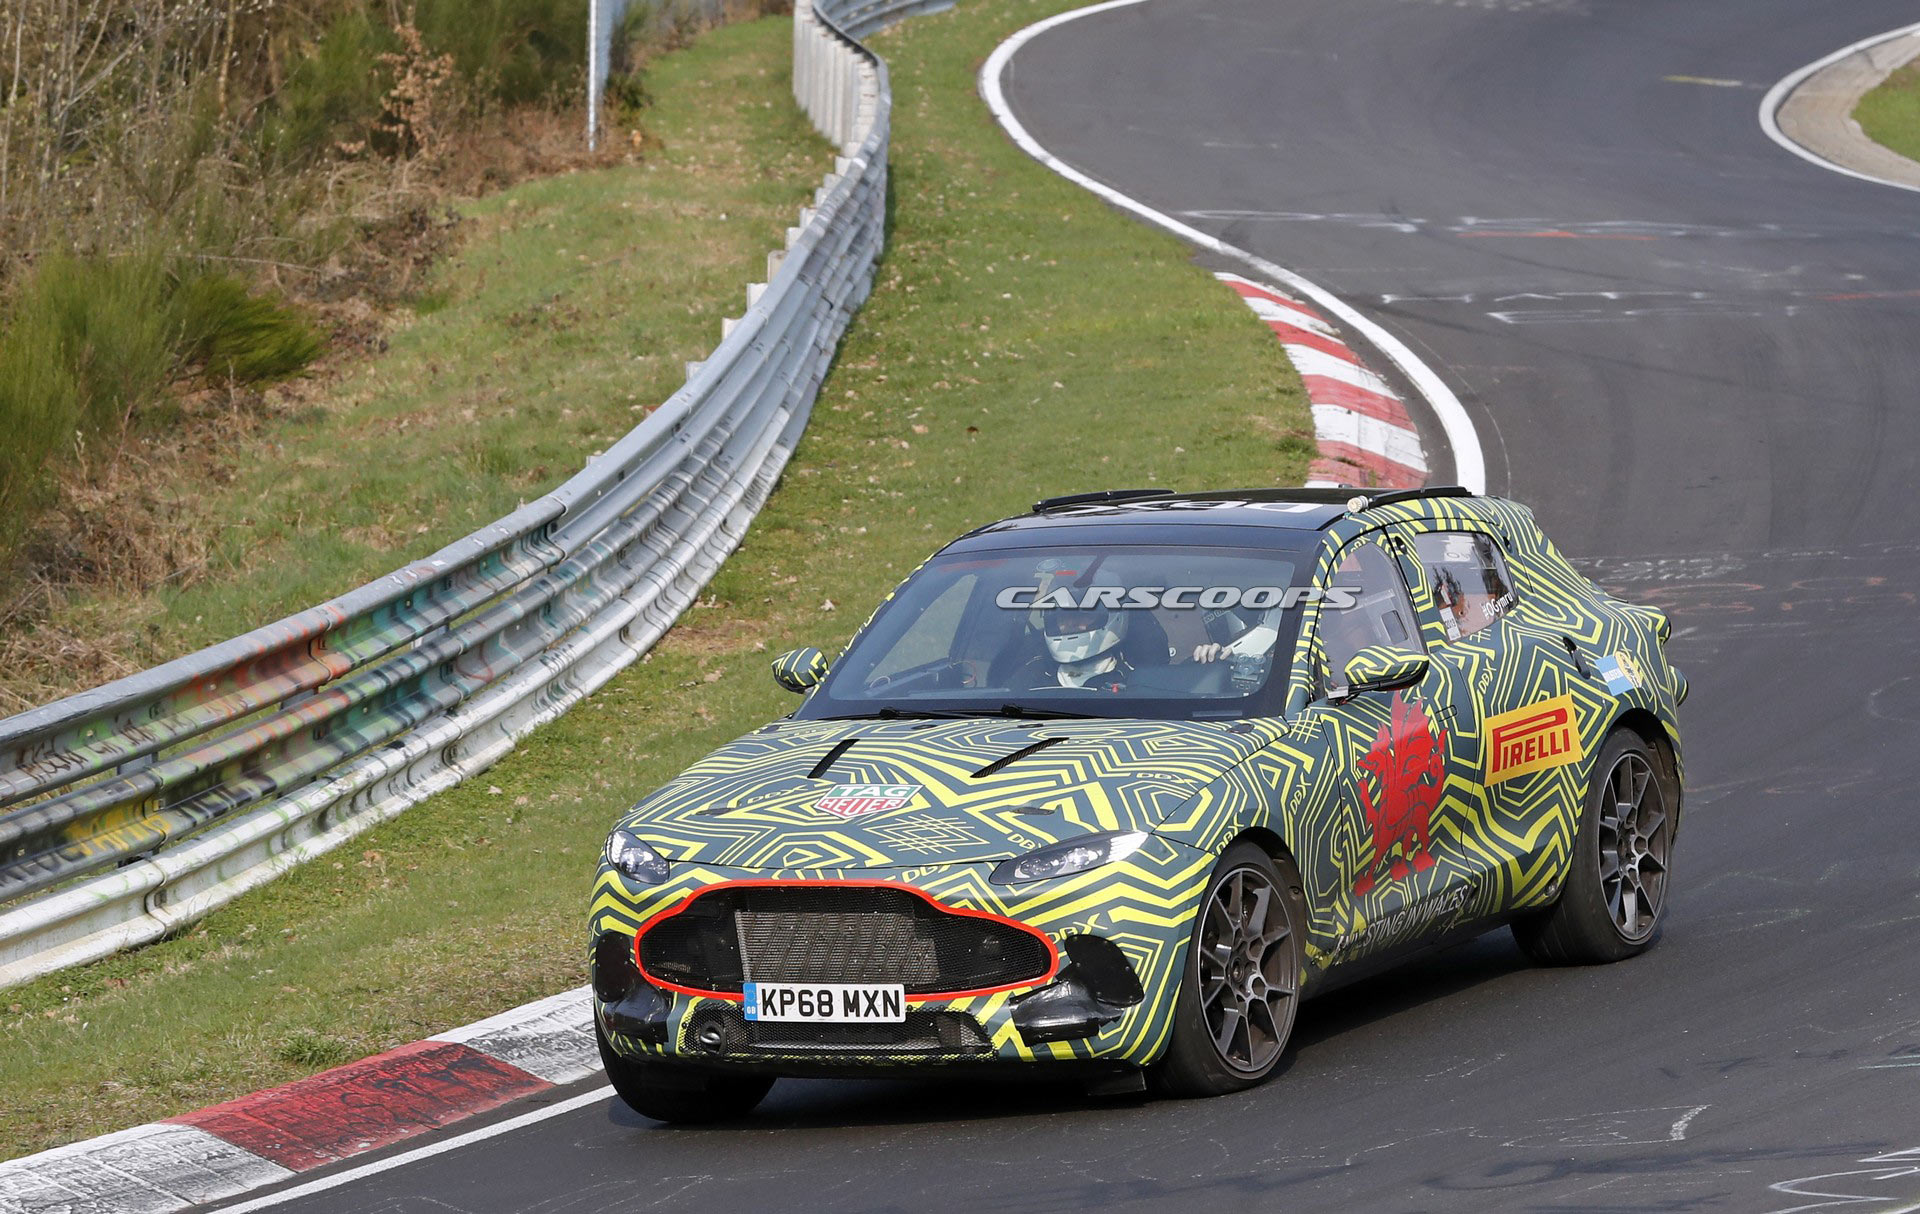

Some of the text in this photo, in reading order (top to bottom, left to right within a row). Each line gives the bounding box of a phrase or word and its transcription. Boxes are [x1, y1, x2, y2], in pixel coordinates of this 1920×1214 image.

[1478, 658, 1496, 694] DBX
[1492, 707, 1570, 773] PIRELLI
[840, 786, 911, 797] TAG
[1136, 772, 1199, 791] DBX
[1290, 772, 1311, 815] DBX
[820, 798, 900, 816] HEUER
[1007, 834, 1042, 850] DB
[1420, 884, 1469, 923] WALES
[761, 988, 834, 1018] KP68
[843, 989, 901, 1018] MXN
